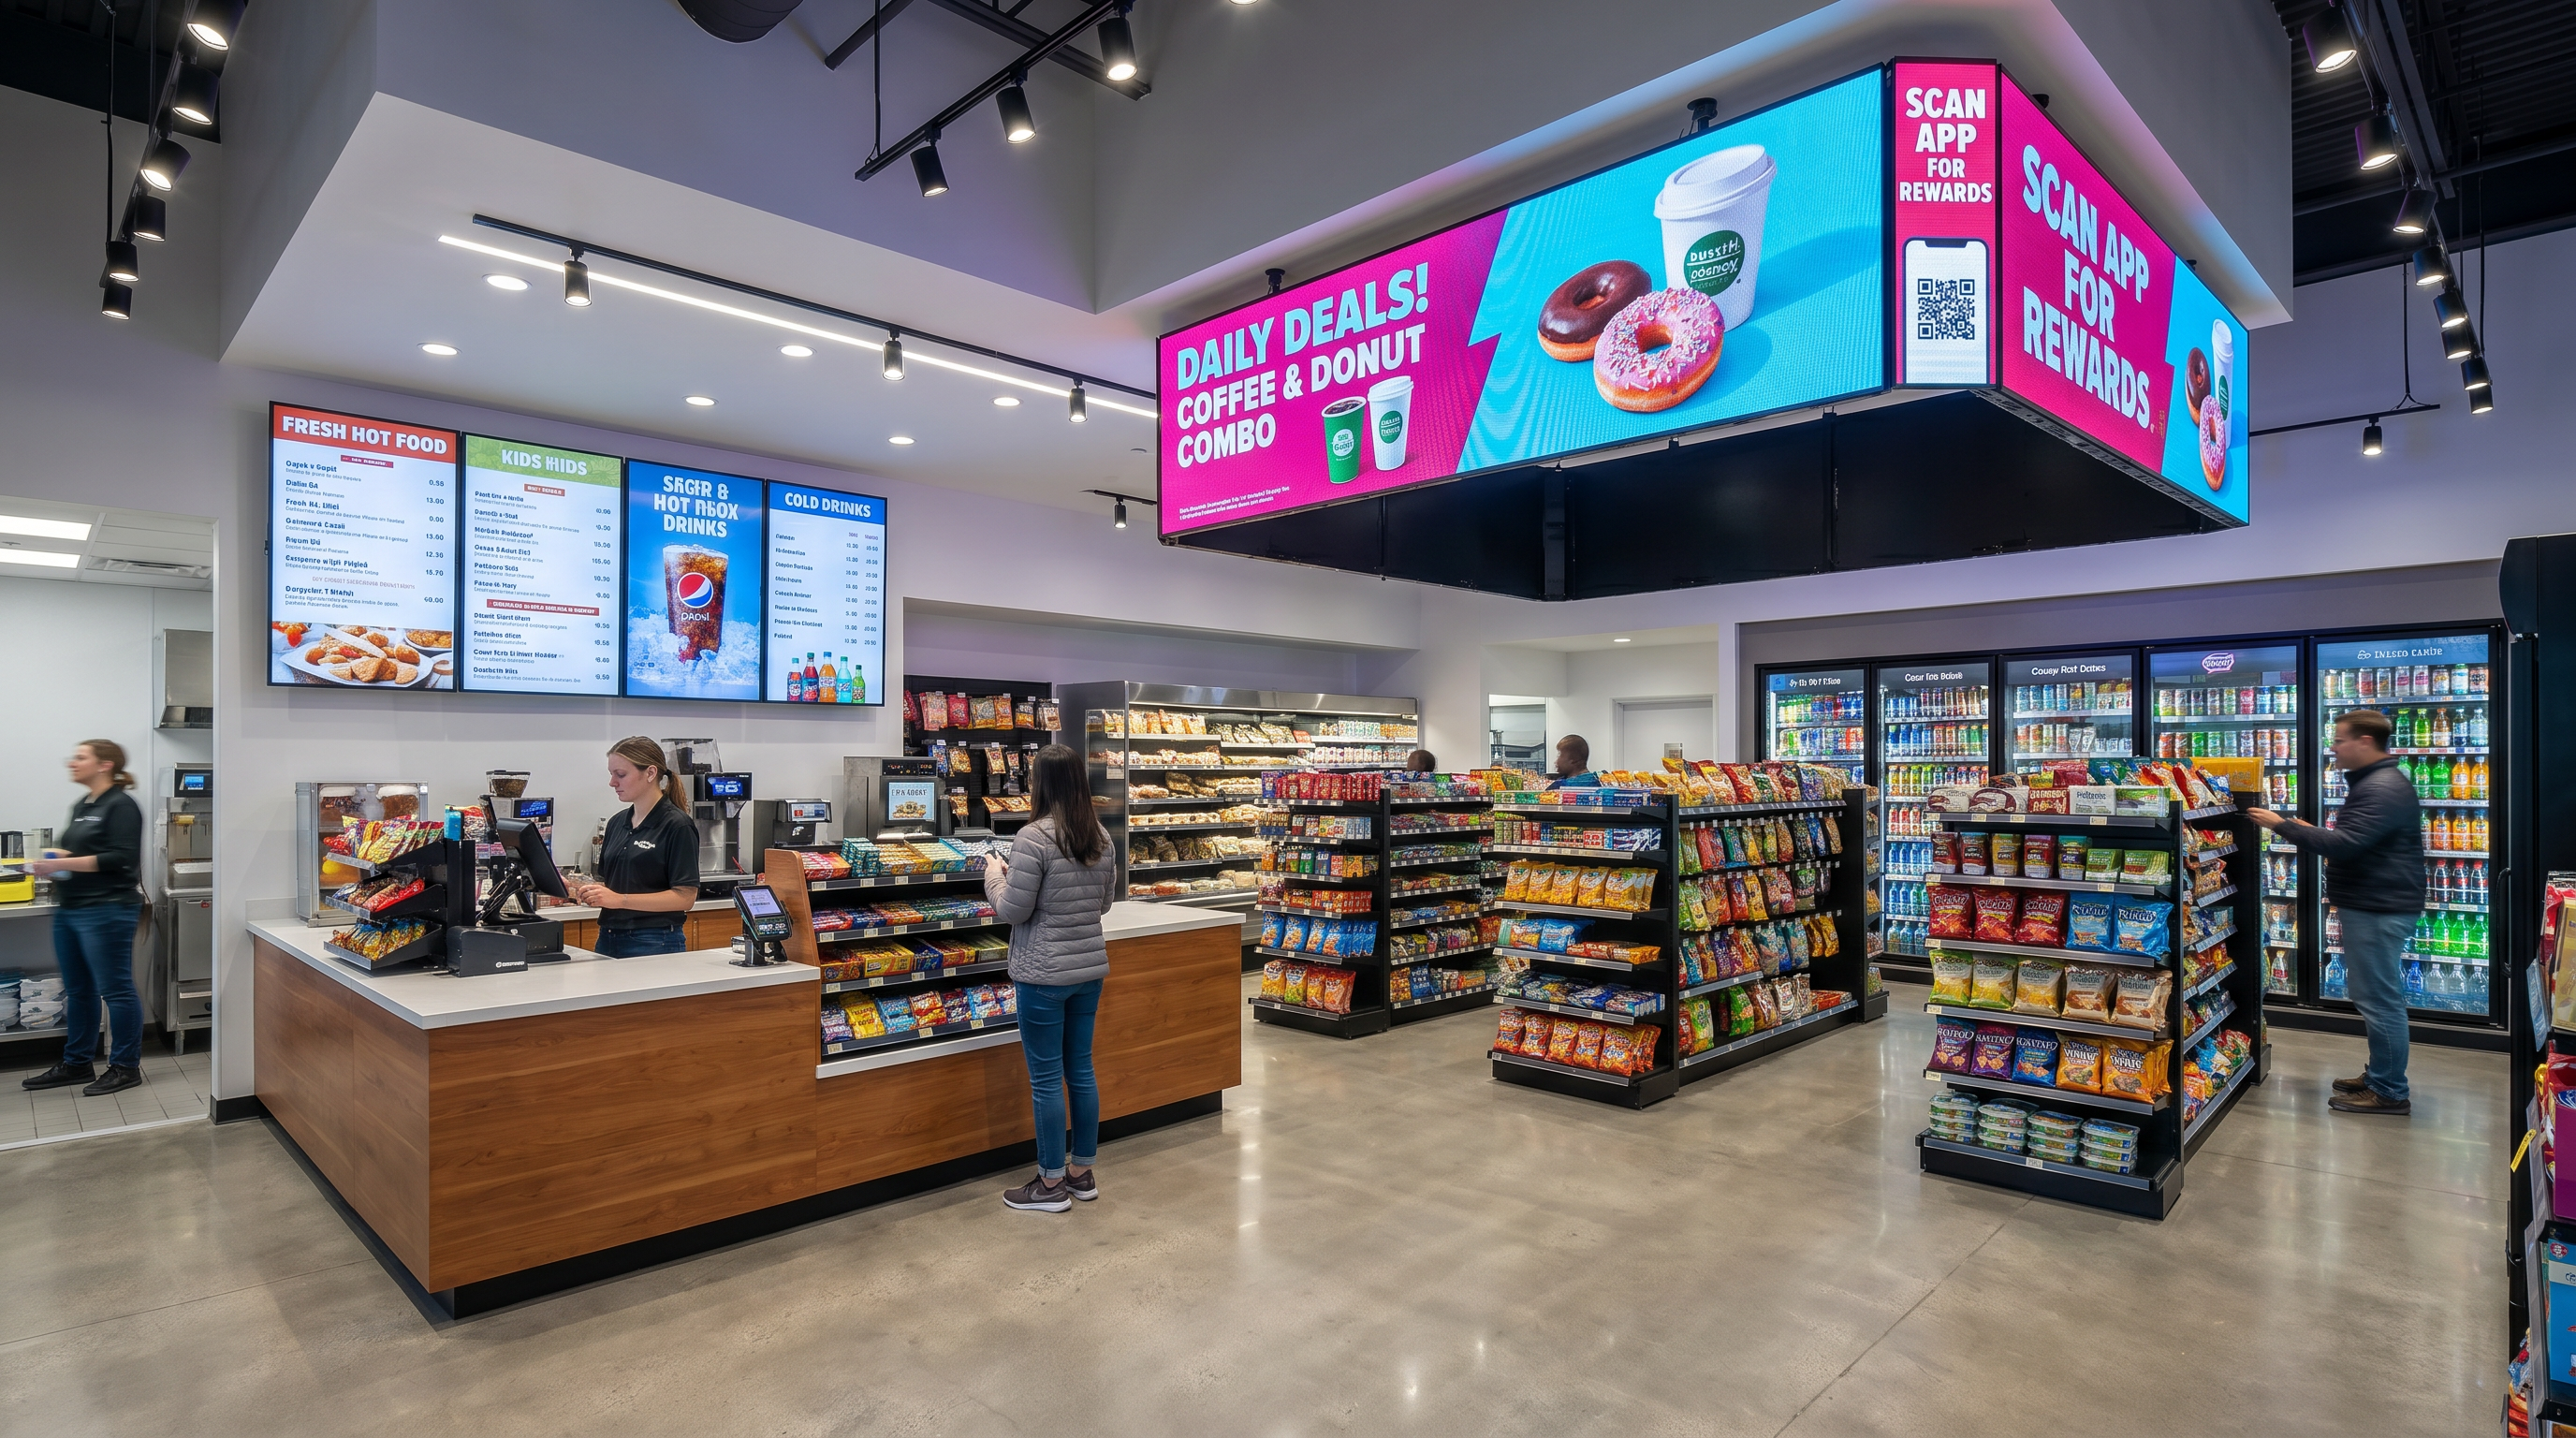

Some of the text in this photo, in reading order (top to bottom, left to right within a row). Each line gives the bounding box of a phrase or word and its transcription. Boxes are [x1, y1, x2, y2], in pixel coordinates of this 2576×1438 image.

[1905, 86, 1986, 120] SCAN
[1915, 123, 1978, 154] APP
[1926, 157, 1966, 179] FOR
[1898, 182, 1993, 203] REWARDS
[2022, 144, 2149, 303] SCAN APP
[2063, 248, 2115, 343] FOR
[1177, 261, 1429, 390] DAILY DEALS!
[2022, 286, 2150, 430] REWARDS
[1177, 322, 1426, 431] COFFEE & DONUT
[283, 415, 447, 455] FRESH HOT FOOD
[1177, 413, 1277, 469] COMBO
[502, 448, 542, 469] KIDS
[653, 492, 691, 514] HOT
[784, 492, 871, 518] COLD DRINKS
[663, 514, 727, 538] DRINKS
